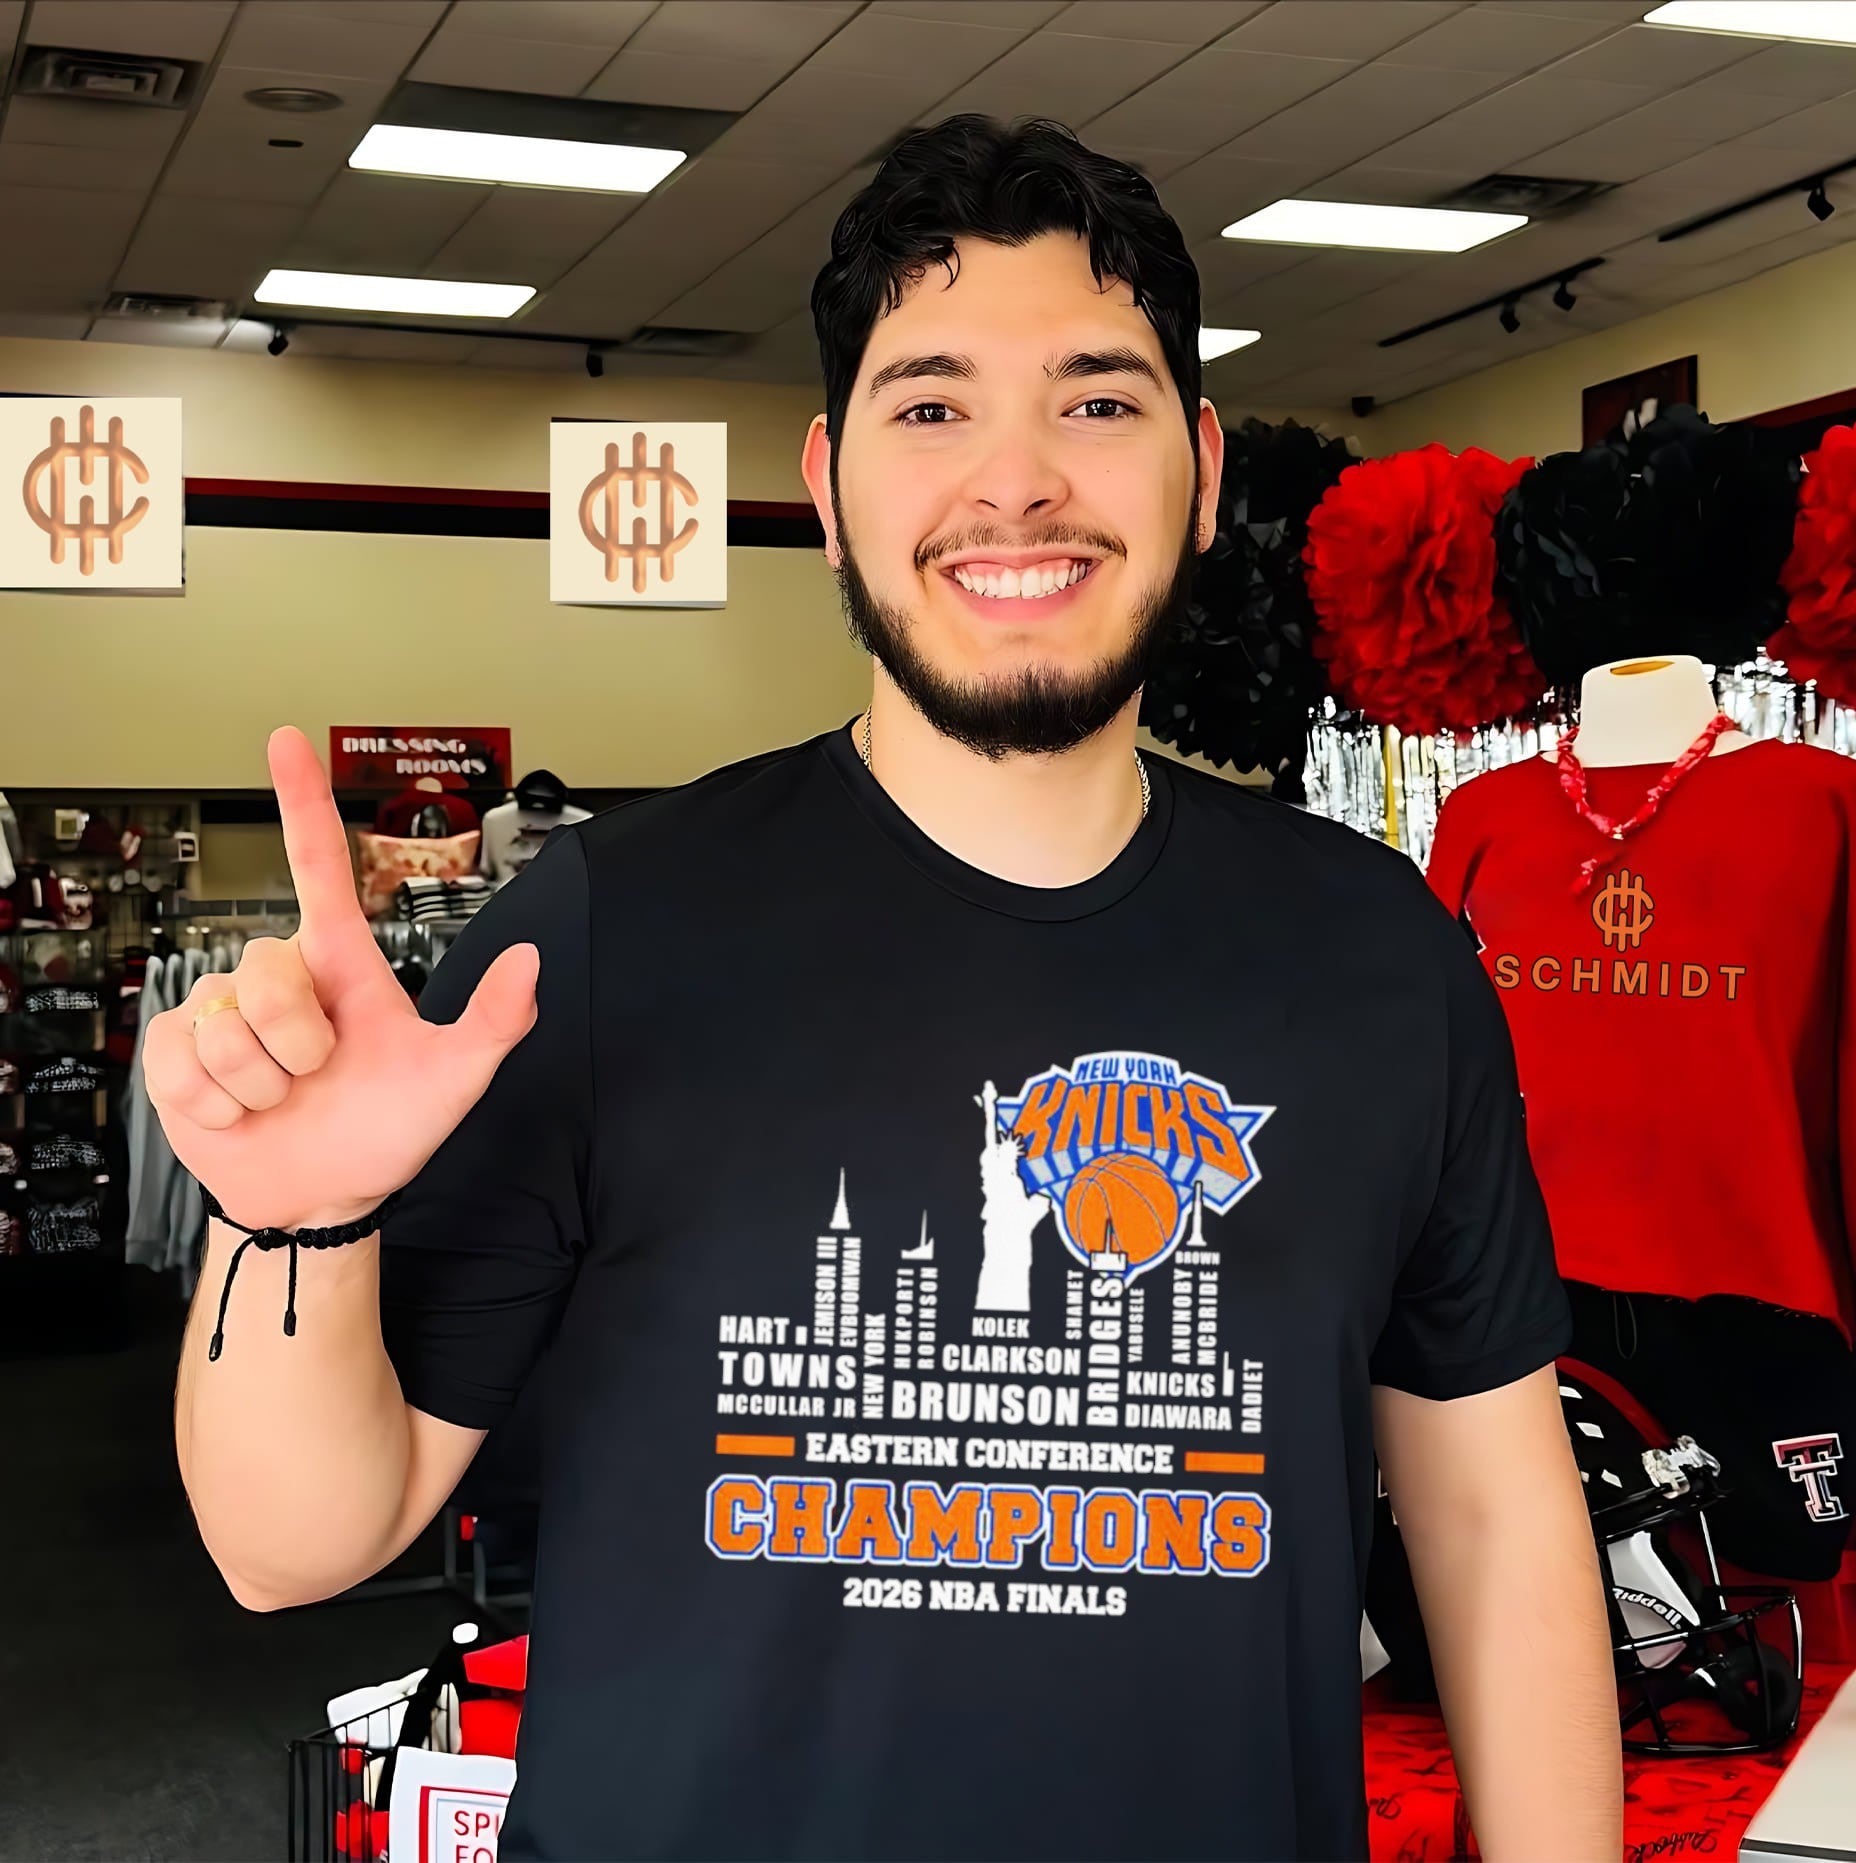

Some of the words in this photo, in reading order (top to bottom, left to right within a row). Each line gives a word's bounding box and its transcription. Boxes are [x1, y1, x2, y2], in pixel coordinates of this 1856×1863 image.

[1494, 954, 1746, 1000] SCHMIDT
[1074, 1057, 1120, 1083] NEW
[1125, 1057, 1177, 1086] YORK
[1013, 1077, 1251, 1183] KNICKS
[1175, 1251, 1220, 1265] BROWN
[813, 1264, 837, 1347] JEMISON
[839, 1237, 861, 1348] EVBUOMWAN
[1065, 1270, 1084, 1340] SHAMET
[719, 1315, 790, 1345] HART
[863, 1313, 886, 1367] YORK
[893, 1268, 914, 1369] HUKPORTI
[917, 1267, 938, 1370] ROBINSON
[971, 1316, 1030, 1339] KOLEK
[1127, 1288, 1145, 1364] YABUSELE
[1171, 1268, 1193, 1365] ANUNOBY
[1197, 1271, 1218, 1366] MCBRIDE
[717, 1350, 857, 1390] TOWNS
[942, 1343, 1081, 1376] CLARKSON
[1086, 1275, 1124, 1427] BRIDGES
[717, 1393, 825, 1417] MCCULLAR
[832, 1397, 857, 1419] JR
[862, 1373, 885, 1419] NEW
[891, 1380, 1080, 1427] BRUNSON
[1126, 1371, 1216, 1398] KNICKS
[1241, 1359, 1263, 1434] DADIET
[1125, 1403, 1232, 1431] DIAWARA
[805, 1432, 958, 1467] EASTERN
[965, 1437, 1174, 1474] CONFERENCE
[705, 1474, 1272, 1578] CHAMPIONS
[842, 1577, 922, 1609] 2026
[929, 1580, 1000, 1612] NBA
[1007, 1583, 1127, 1616] FINALS
